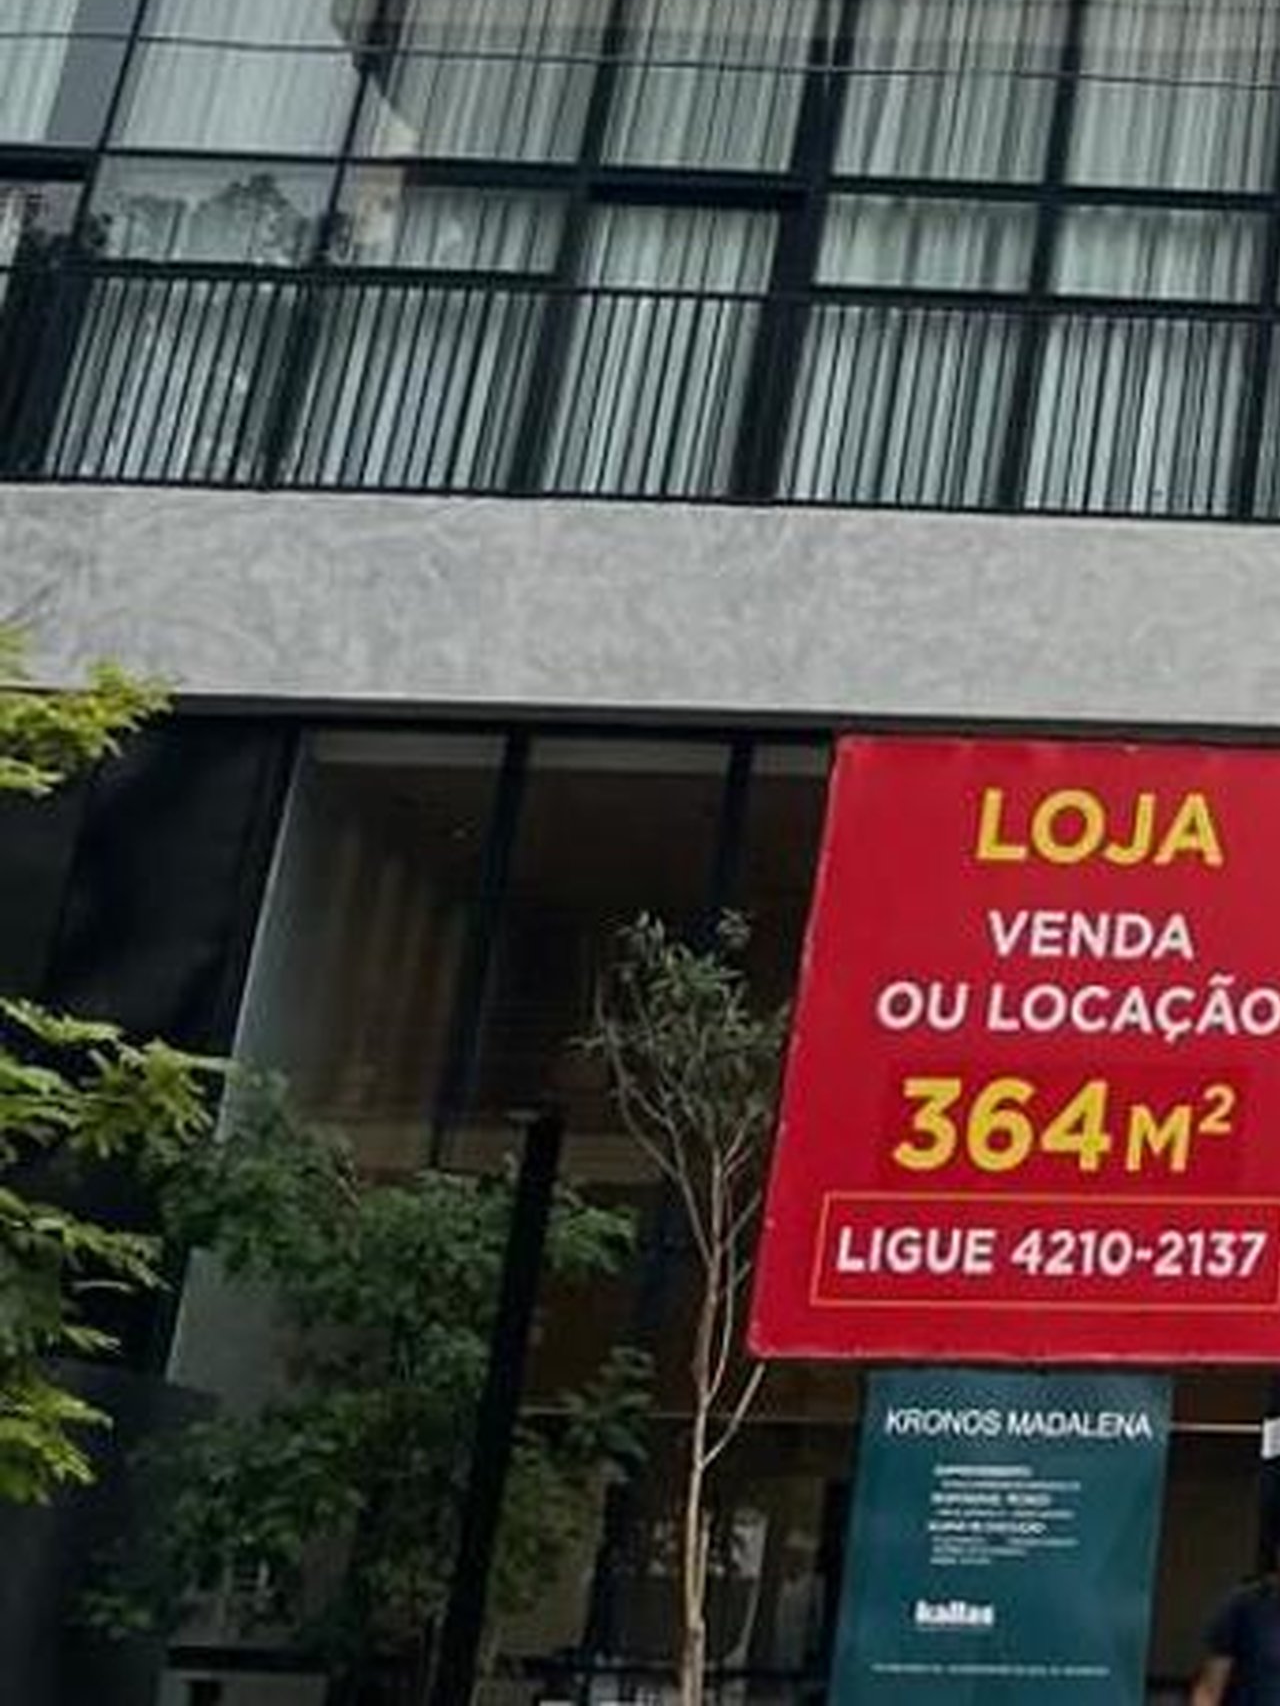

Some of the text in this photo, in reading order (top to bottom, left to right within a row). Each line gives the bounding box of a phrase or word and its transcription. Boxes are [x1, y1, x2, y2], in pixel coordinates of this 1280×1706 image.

[976, 787, 1223, 866] LOJA
[987, 910, 1194, 961] VENDA
[876, 981, 968, 1030] OU
[837, 1227, 1267, 1277] LIGUE 4210-2137
[885, 1408, 1152, 1438] KRONOS MADALENA
